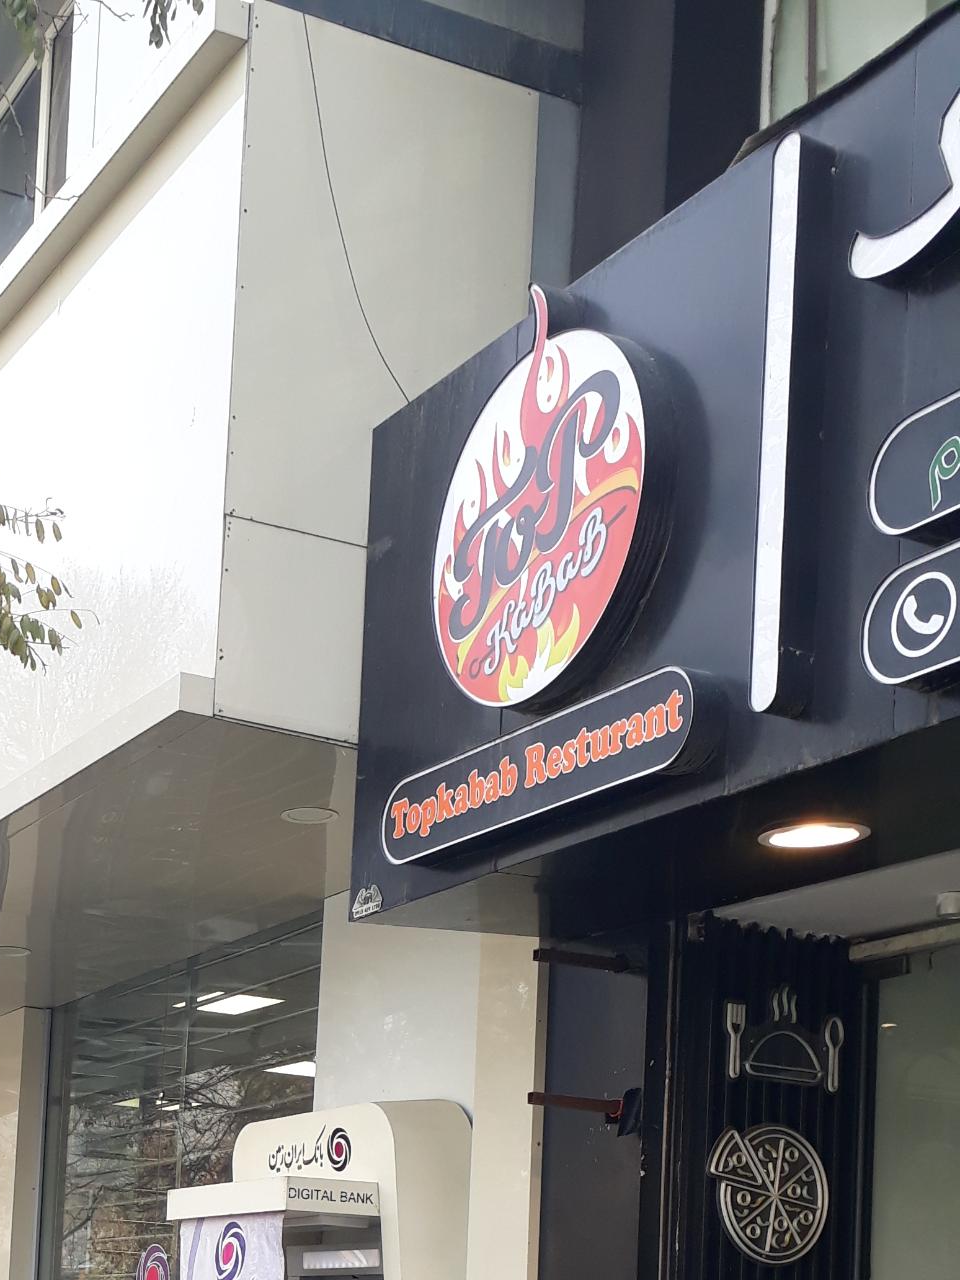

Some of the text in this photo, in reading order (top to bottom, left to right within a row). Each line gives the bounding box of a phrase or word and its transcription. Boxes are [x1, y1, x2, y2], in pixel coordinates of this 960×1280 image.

[391, 688, 684, 841] Topkabab Resturant
[268, 1123, 327, 1173] بانک ایران زمین
[288, 1187, 374, 1205] DIGITAL BANK
